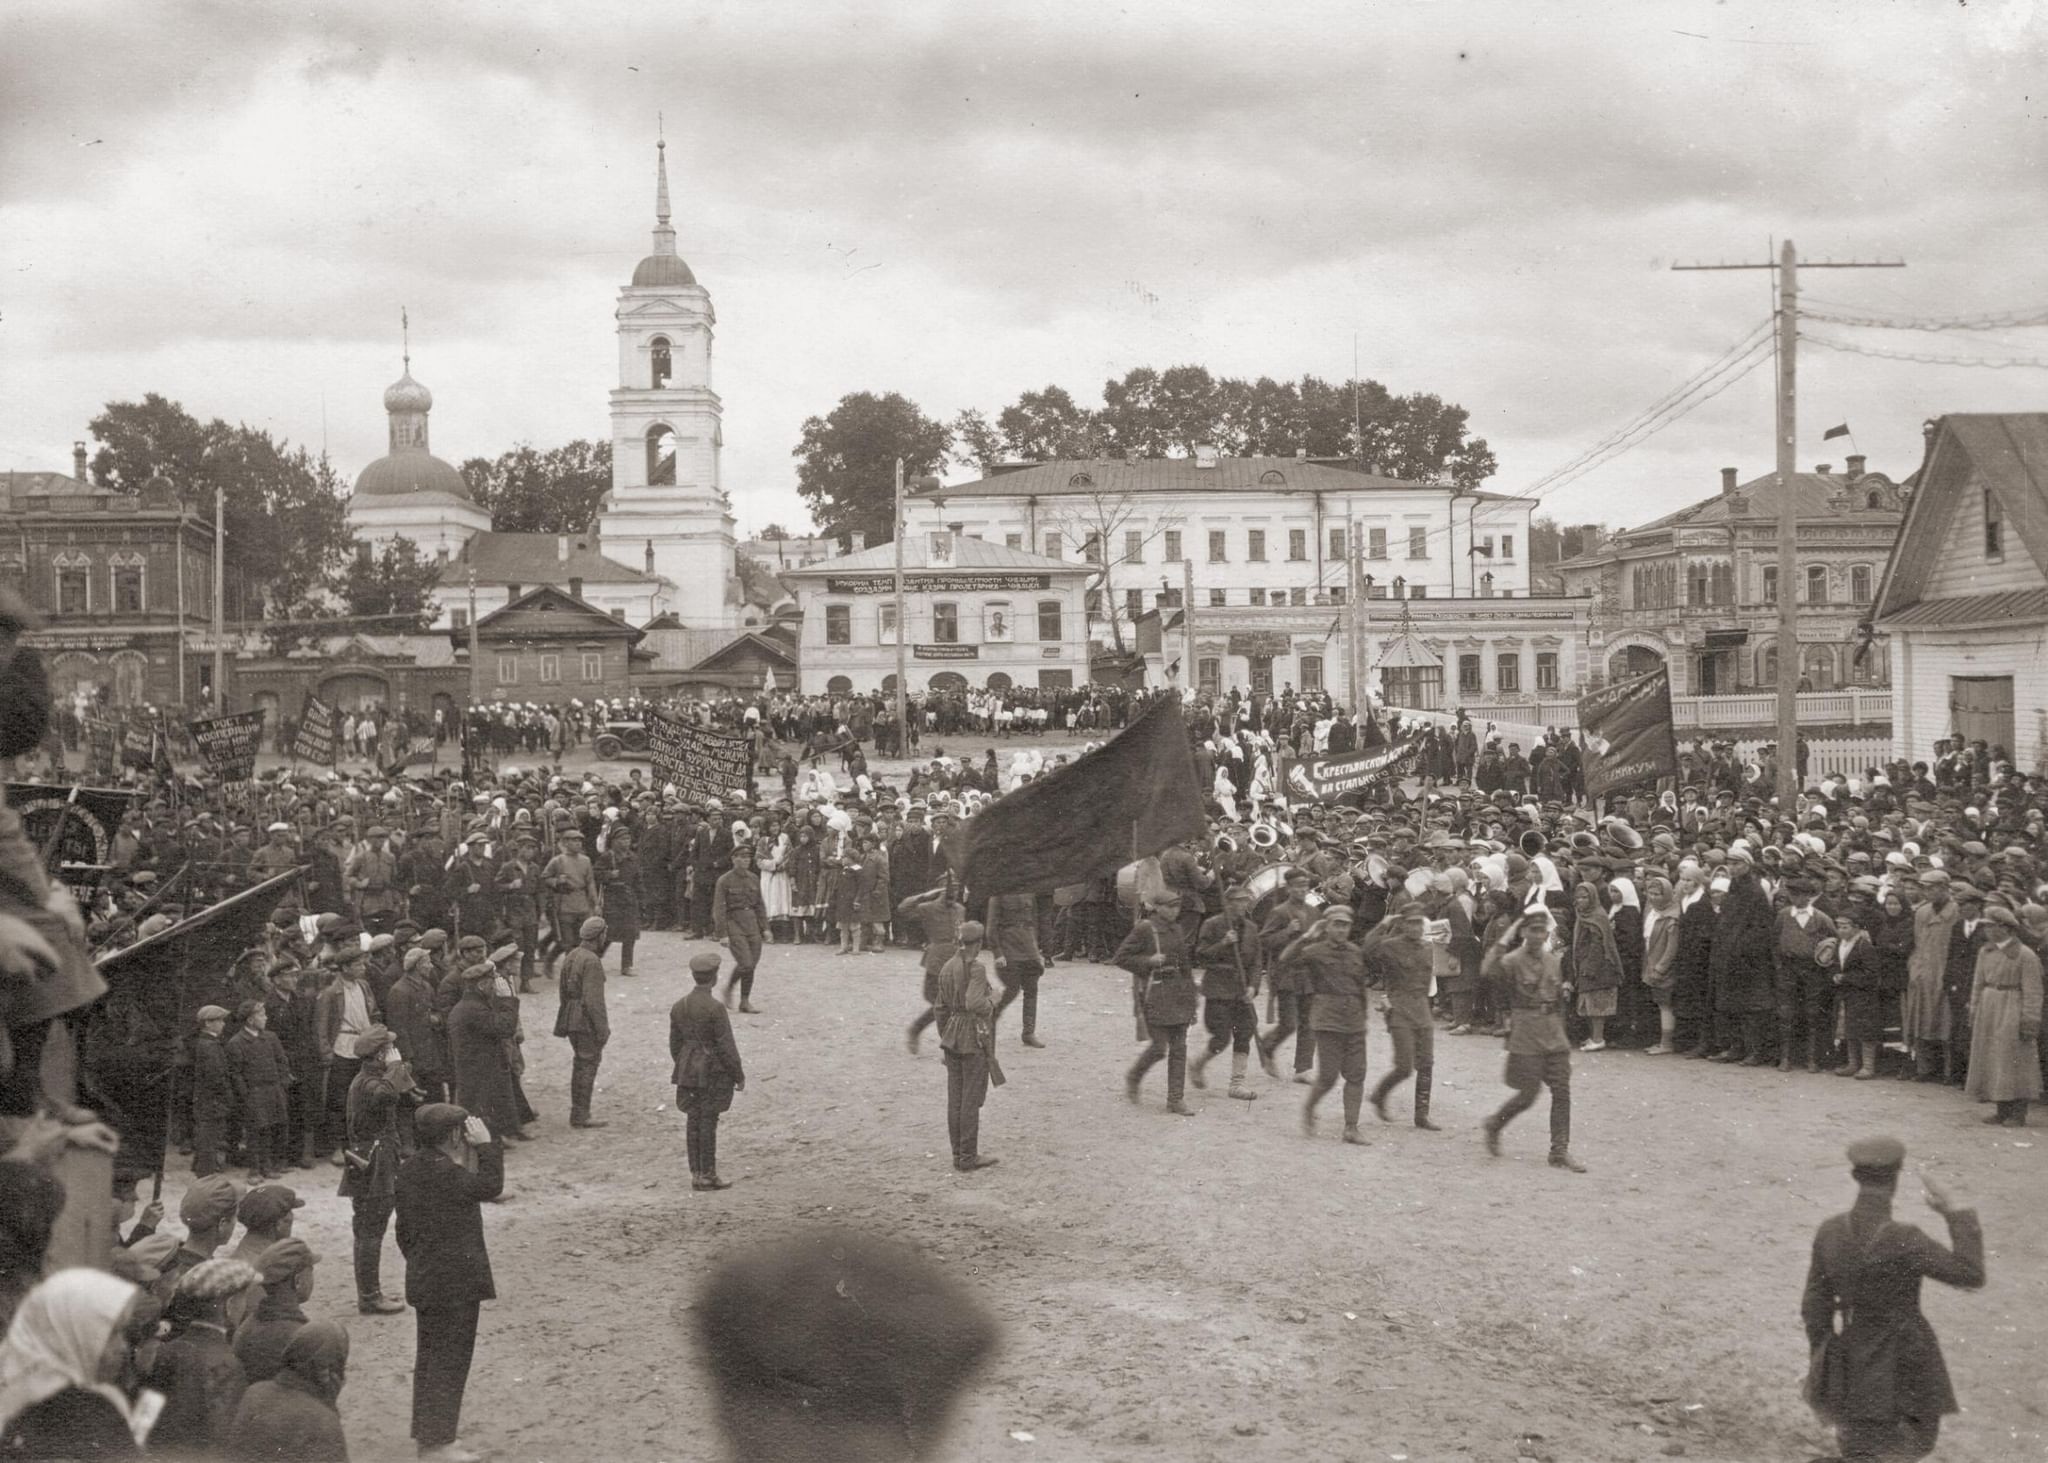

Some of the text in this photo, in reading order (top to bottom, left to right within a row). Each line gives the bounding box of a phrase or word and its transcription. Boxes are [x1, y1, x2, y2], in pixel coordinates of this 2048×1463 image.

[196, 722, 260, 744] КООПЕРАЦИИ
[212, 716, 240, 730] РОСТ
[680, 736, 704, 752] УДАР
[736, 762, 747, 777] ДА
[1322, 746, 1388, 779] КРЕСТЬЯНСКОЙ
[671, 771, 723, 796] ОТЕЧЕСТВО
[1321, 769, 1390, 795] НА СТАЛЬНОГО
